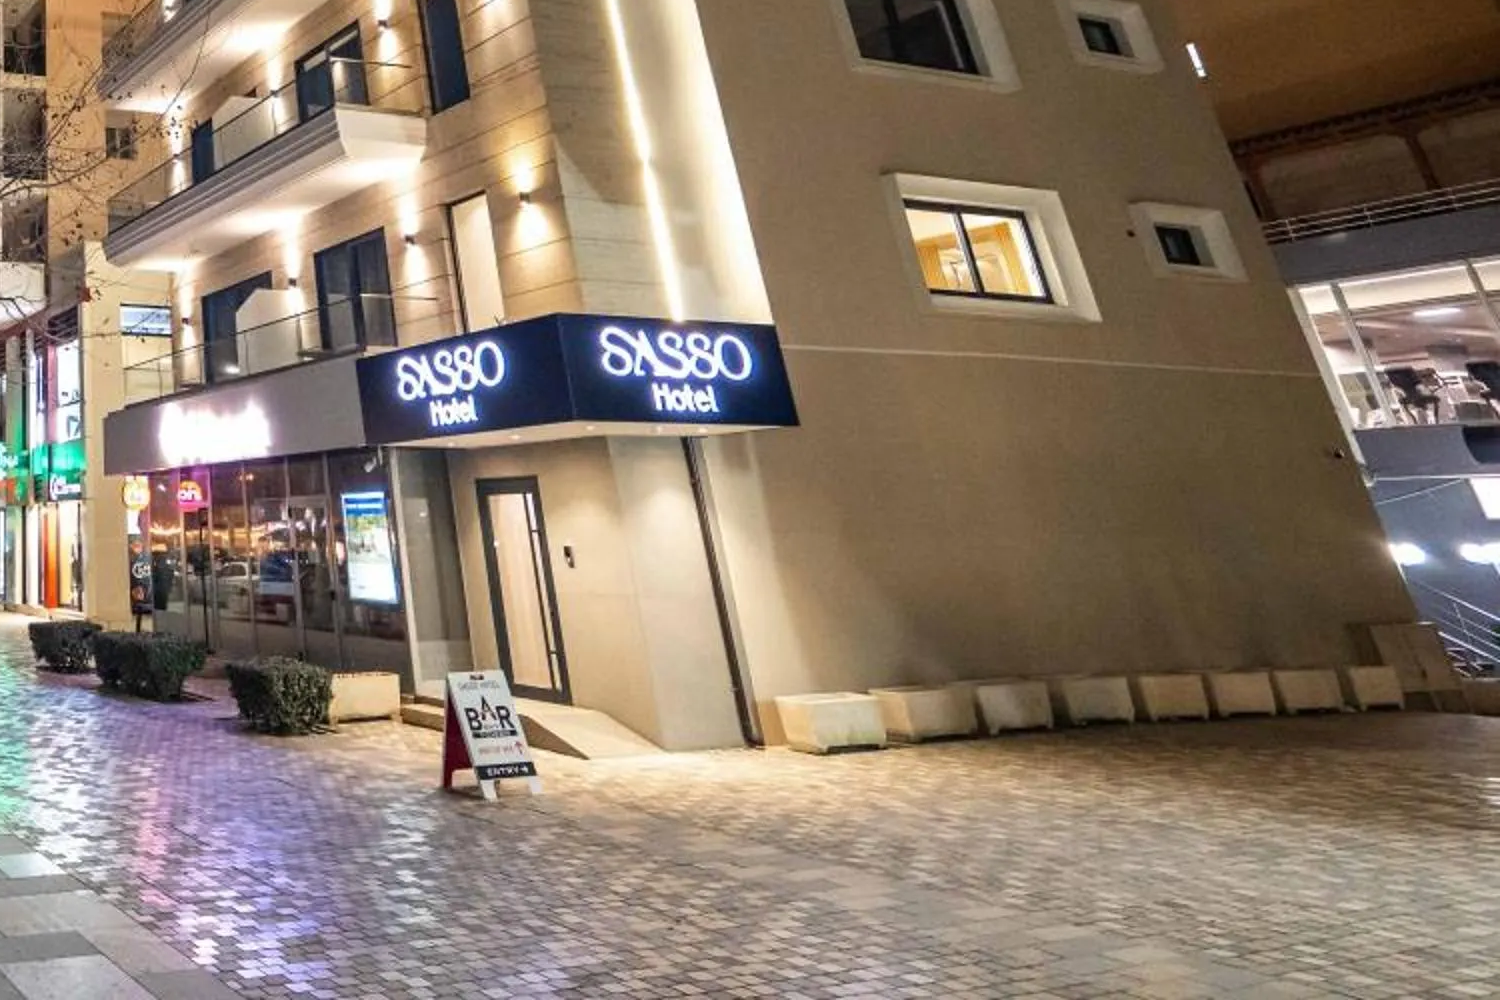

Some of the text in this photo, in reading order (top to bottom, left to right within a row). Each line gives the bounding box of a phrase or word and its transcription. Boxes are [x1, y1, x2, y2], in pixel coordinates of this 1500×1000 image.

[397, 341, 504, 401] SASSO
[600, 326, 752, 381] SASSO
[429, 399, 478, 427] Hotel
[652, 383, 719, 413] Hotel
[464, 696, 515, 731] BAR
